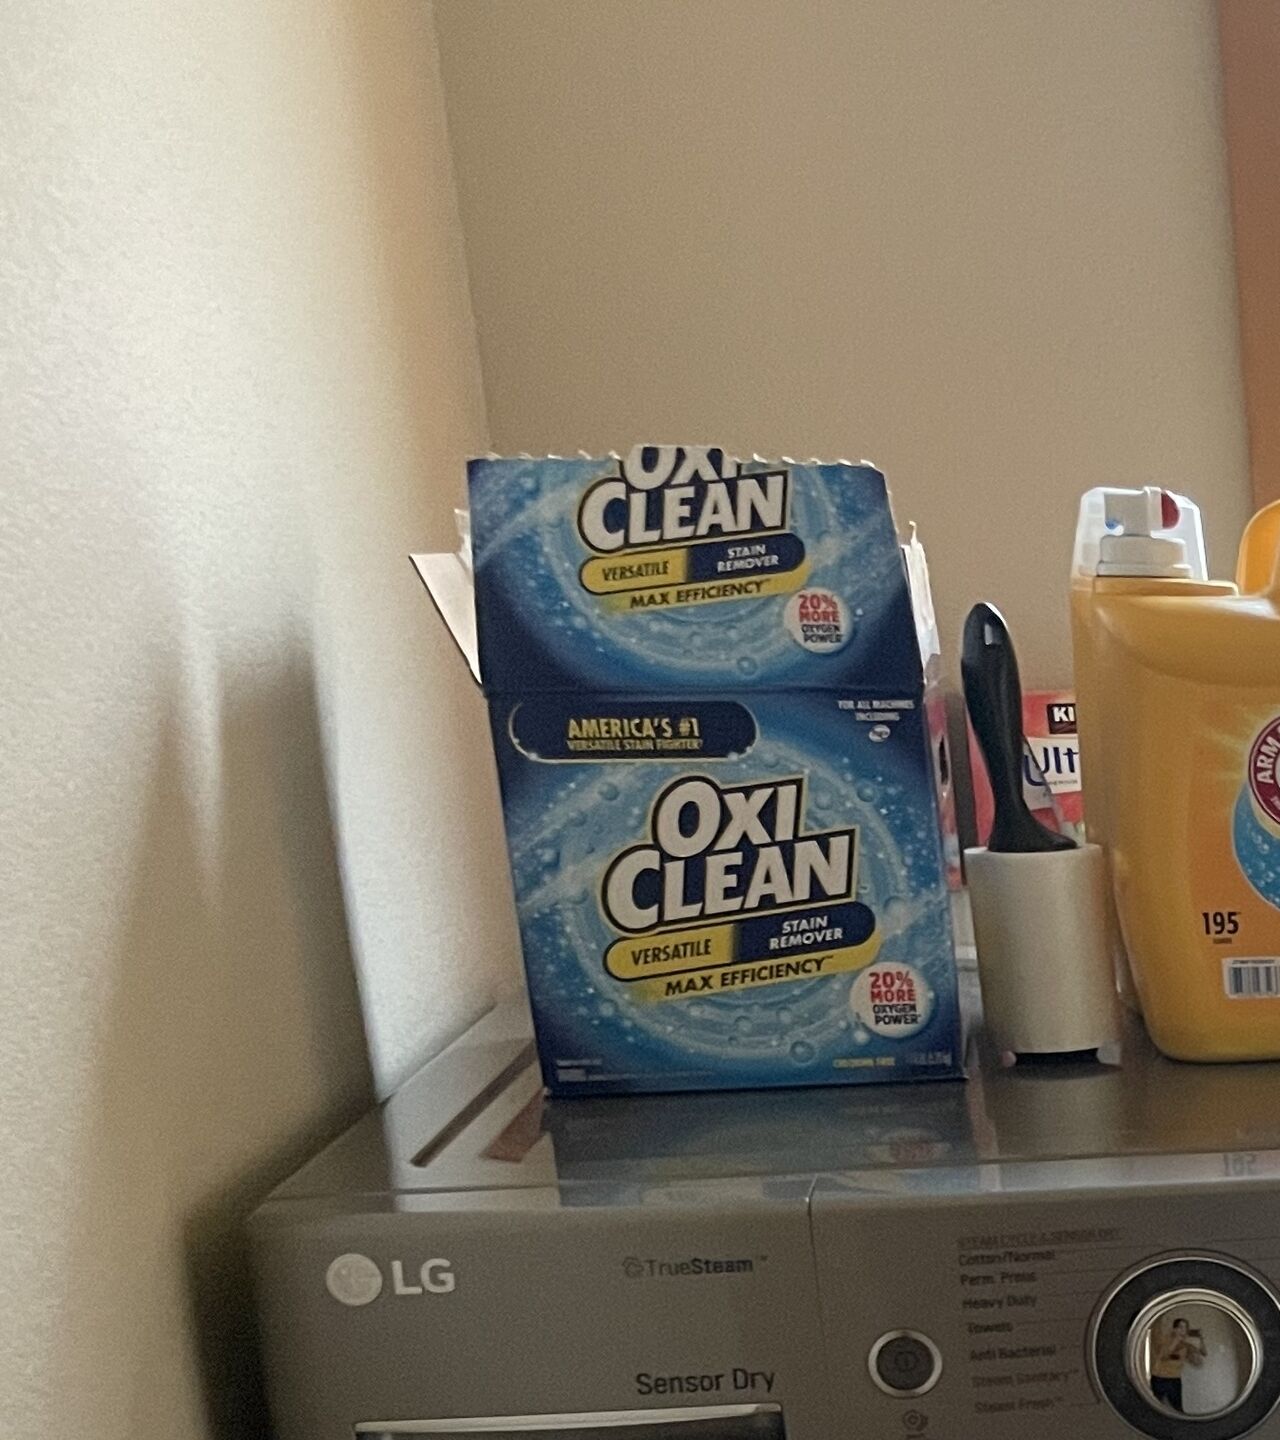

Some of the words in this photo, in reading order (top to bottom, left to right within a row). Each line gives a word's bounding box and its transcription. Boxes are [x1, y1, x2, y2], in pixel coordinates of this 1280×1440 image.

[581, 474, 784, 550] CLEAN
[727, 544, 766, 558] STAIN
[602, 560, 670, 581] VERSATILE
[717, 555, 779, 573] REMOVER
[631, 592, 670, 609] MAX
[799, 594, 838, 610] 20%
[799, 611, 839, 623] MORE
[801, 624, 840, 633] OXYGEN
[569, 718, 672, 738] AMERICA'S
[679, 718, 699, 738] #1
[657, 780, 797, 857] OXI
[606, 835, 850, 930] CLEAN
[782, 916, 828, 934] STAIN
[1202, 912, 1240, 935] 195
[769, 928, 843, 950] REMOVER
[631, 939, 711, 966] VERSATILE
[665, 975, 713, 996] MAX
[869, 970, 914, 989] 20%
[870, 989, 916, 1003] MORE
[872, 1003, 917, 1014] OXYGEN
[645, 1257, 753, 1276] TrueSteam
[392, 1259, 455, 1295] LG
[636, 1369, 724, 1395] Sensor
[733, 1368, 775, 1393] Dry
